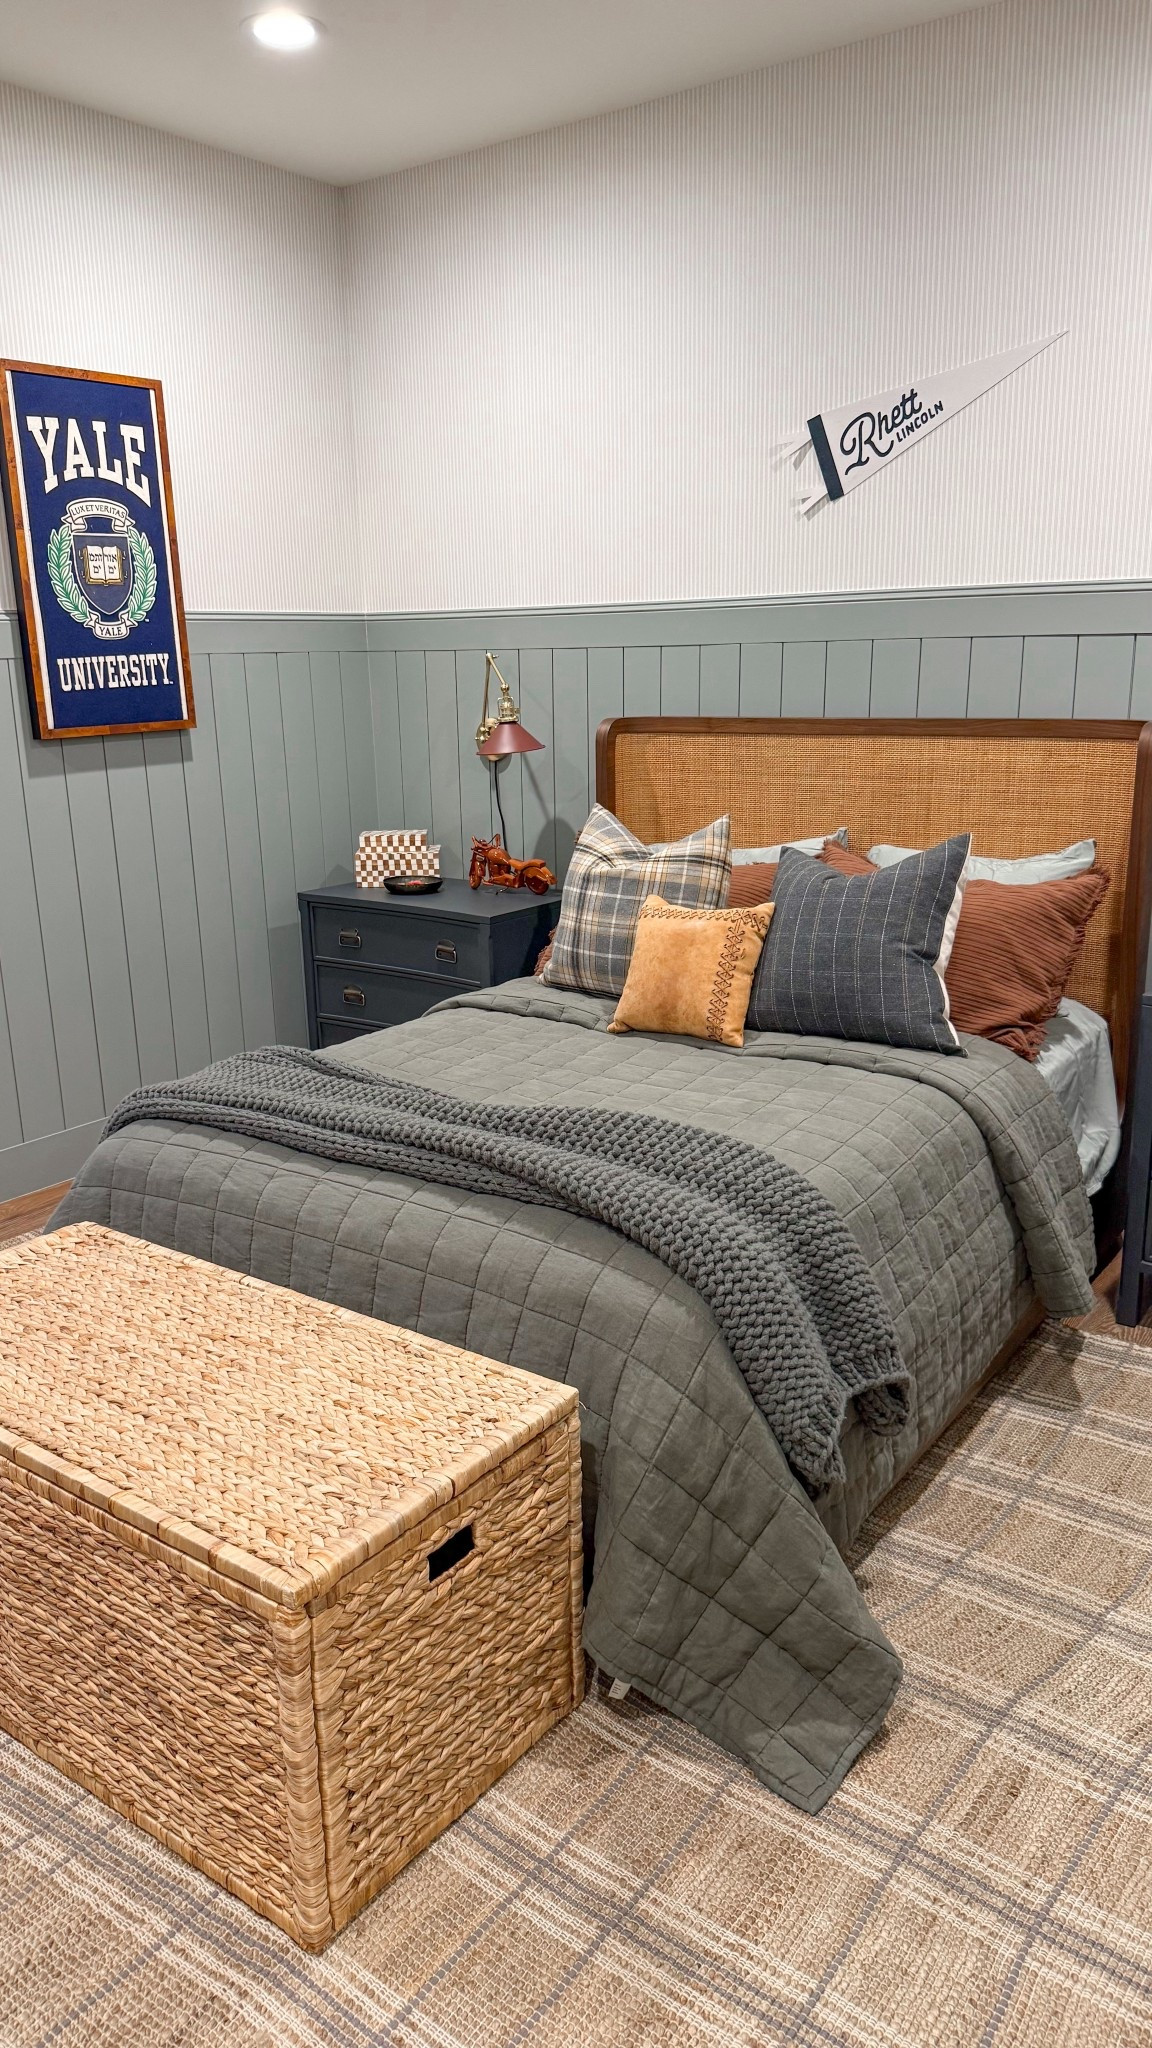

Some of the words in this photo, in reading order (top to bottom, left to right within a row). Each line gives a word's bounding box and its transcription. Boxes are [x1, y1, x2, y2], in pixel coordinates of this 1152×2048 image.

[840, 388, 922, 475] Rhett
[896, 400, 944, 443] LINCOLN
[26, 416, 151, 508] YALE
[71, 505, 85, 515] LUX
[86, 504, 94, 512] ET
[95, 504, 125, 518] VERITAS
[99, 626, 123, 636] YALE
